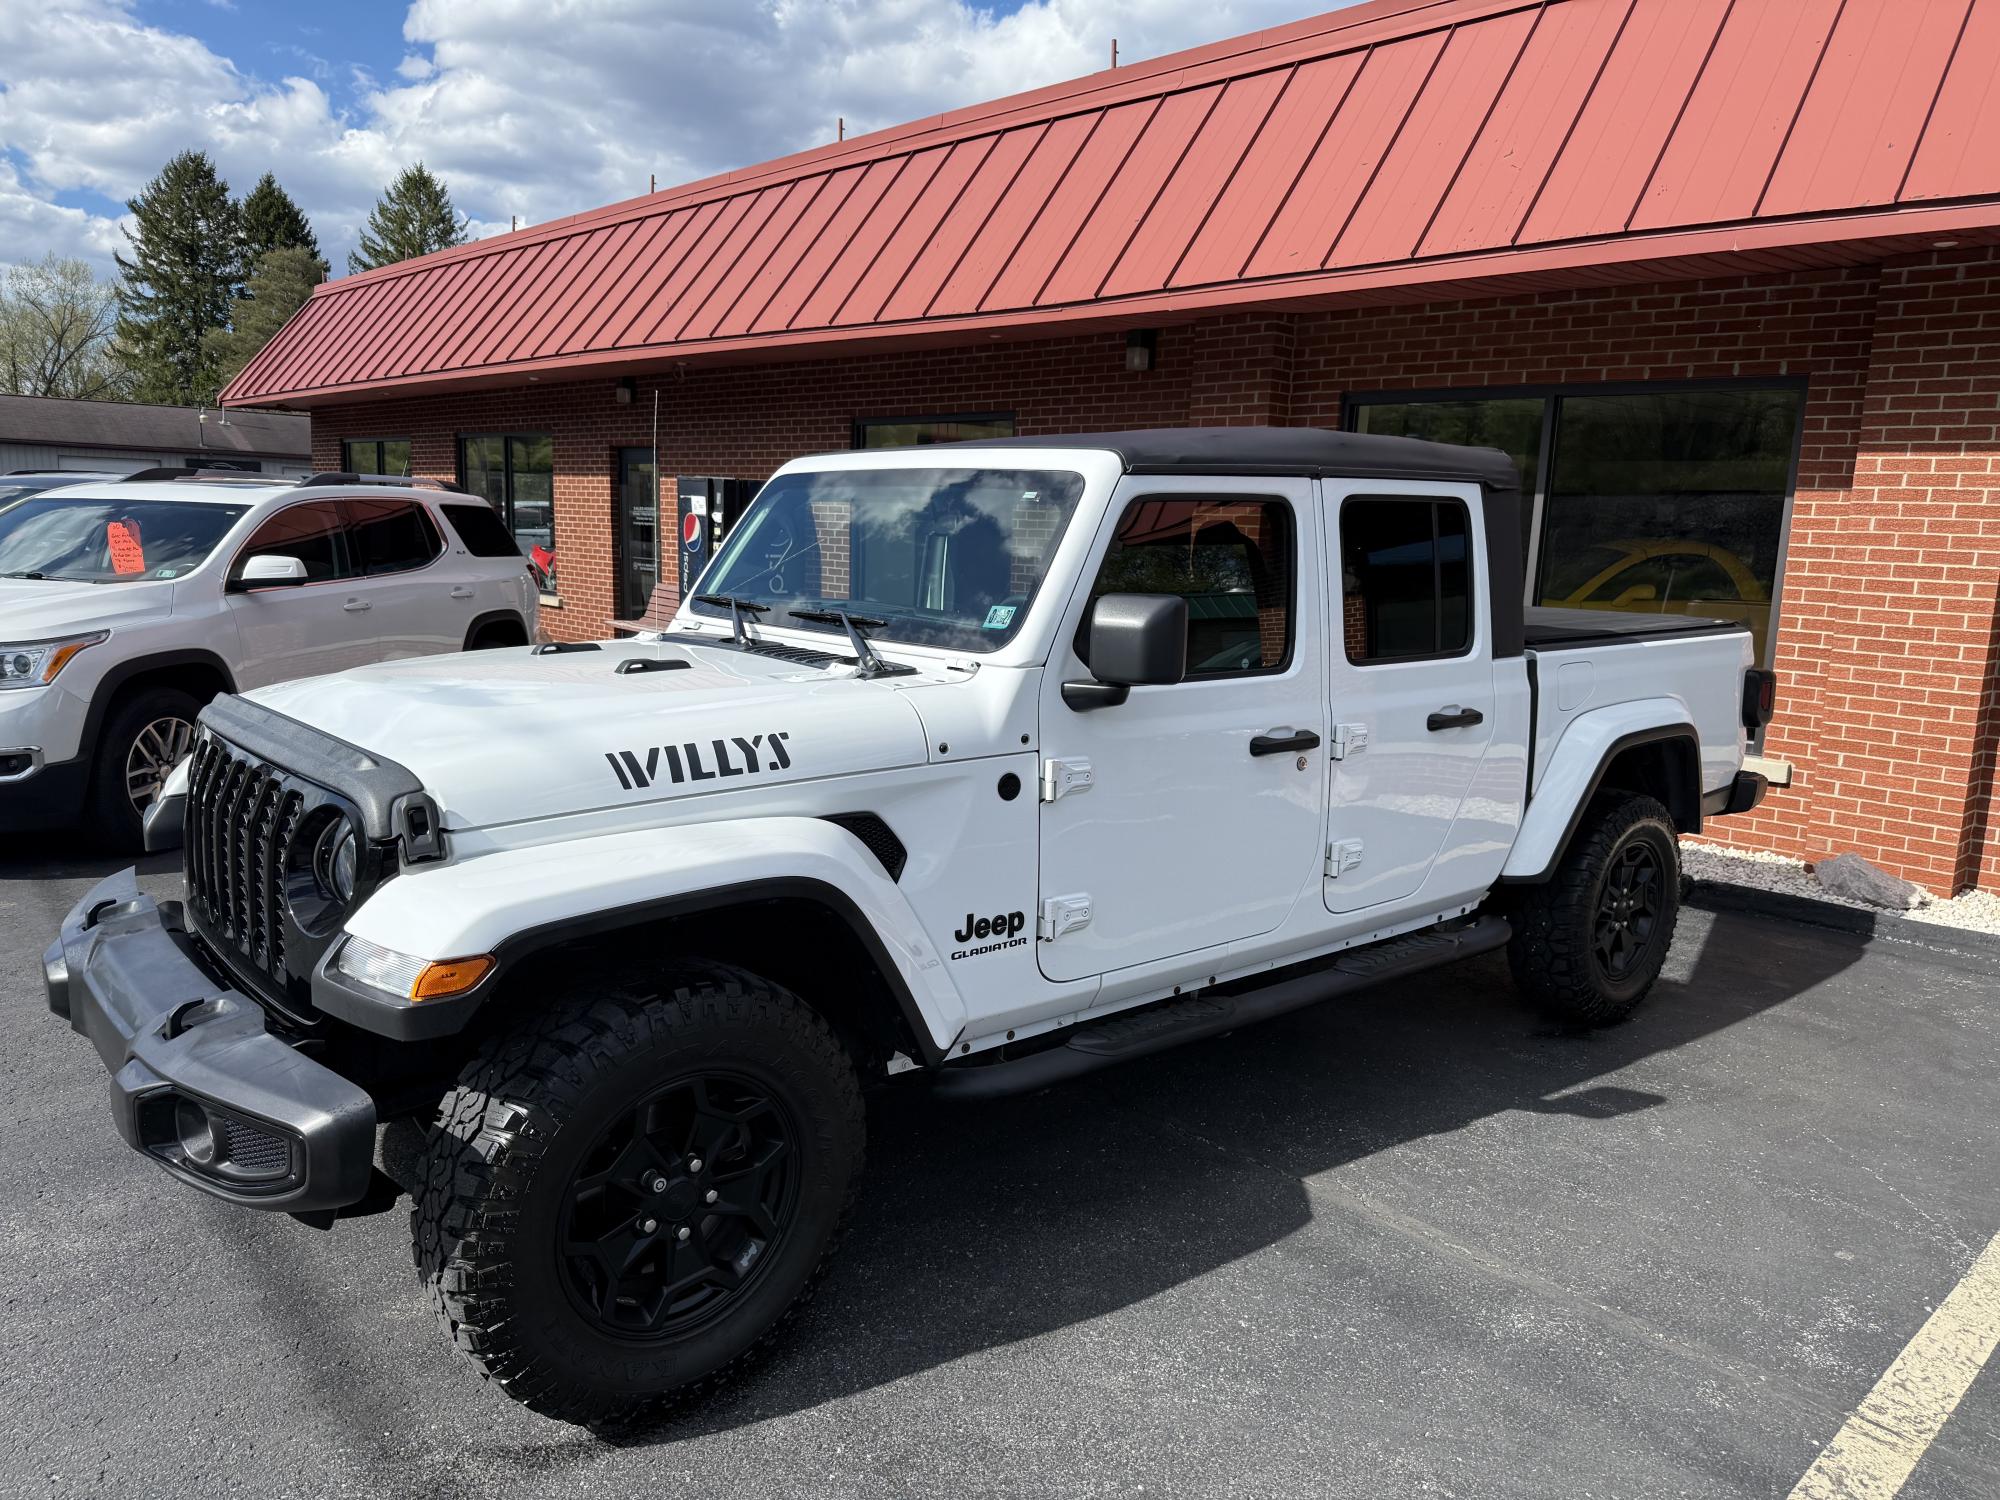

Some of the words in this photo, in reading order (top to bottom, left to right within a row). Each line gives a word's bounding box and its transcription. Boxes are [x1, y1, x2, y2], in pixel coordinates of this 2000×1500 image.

[605, 732, 791, 790] WILLYS
[954, 911, 1025, 943] Jeep
[951, 937, 1027, 961] GLADIATOR
